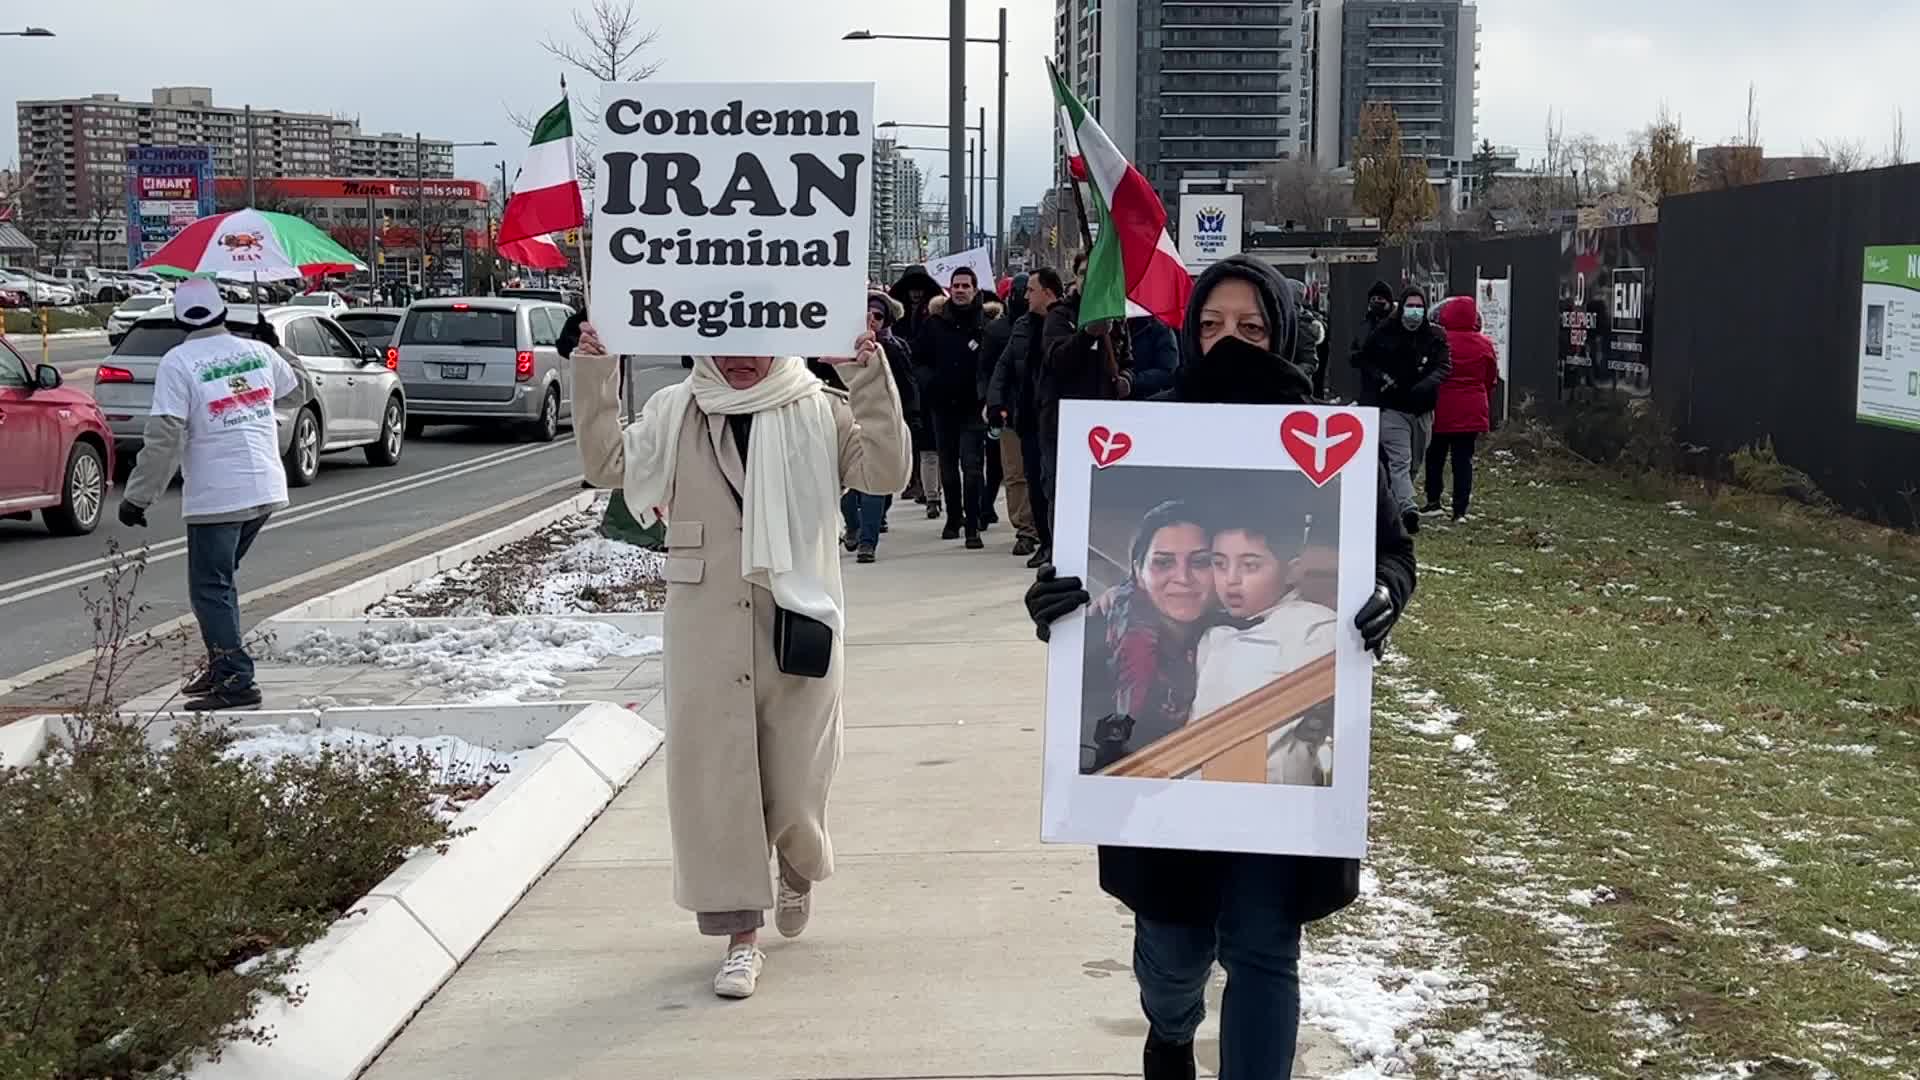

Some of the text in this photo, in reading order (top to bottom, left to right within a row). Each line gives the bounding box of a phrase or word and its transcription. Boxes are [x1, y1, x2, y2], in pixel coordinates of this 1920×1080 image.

[605, 99, 860, 136] Condemn
[128, 149, 208, 160] RICHMOND
[601, 151, 865, 217] IRAN
[232, 253, 262, 262] IRAN
[609, 227, 851, 267] Criminal
[628, 289, 828, 338] Regime
[1614, 282, 1642, 319] ELM
